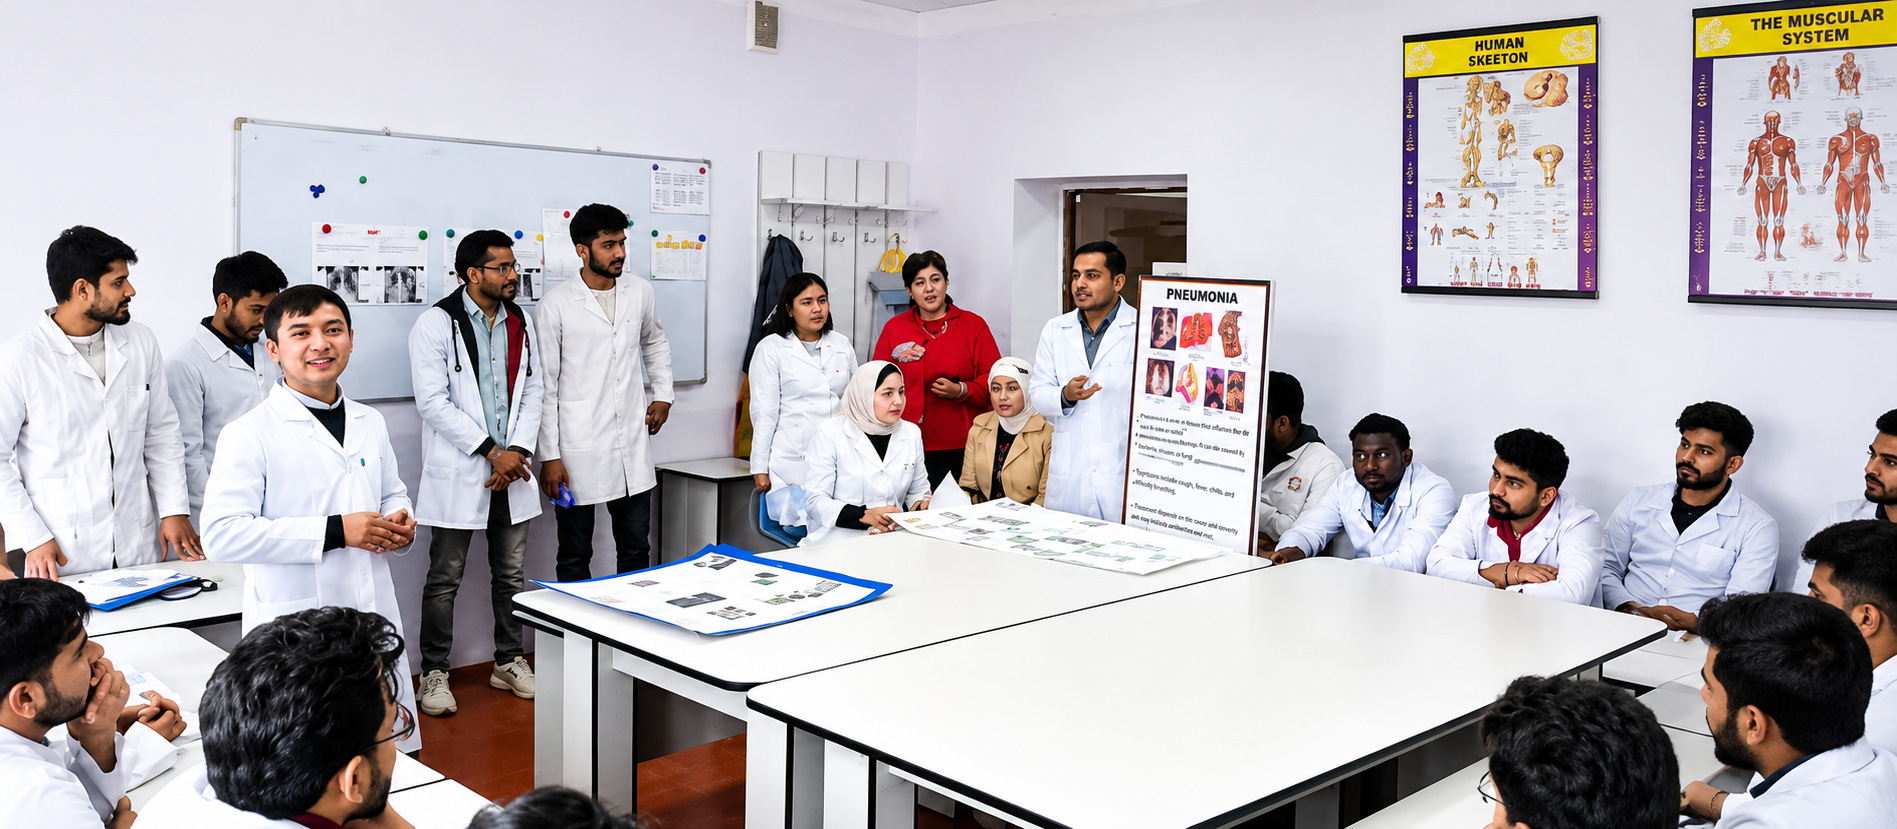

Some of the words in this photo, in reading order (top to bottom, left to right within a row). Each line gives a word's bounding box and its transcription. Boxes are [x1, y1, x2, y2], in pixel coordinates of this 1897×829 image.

[1751, 16, 1782, 30] THE
[1788, 8, 1884, 28] MUSCULAR
[1475, 37, 1524, 52] HUMAN
[1782, 28, 1849, 46] SYSTEM
[1468, 52, 1528, 66] SKEETON
[1166, 288, 1238, 304] PNEUMONIA
